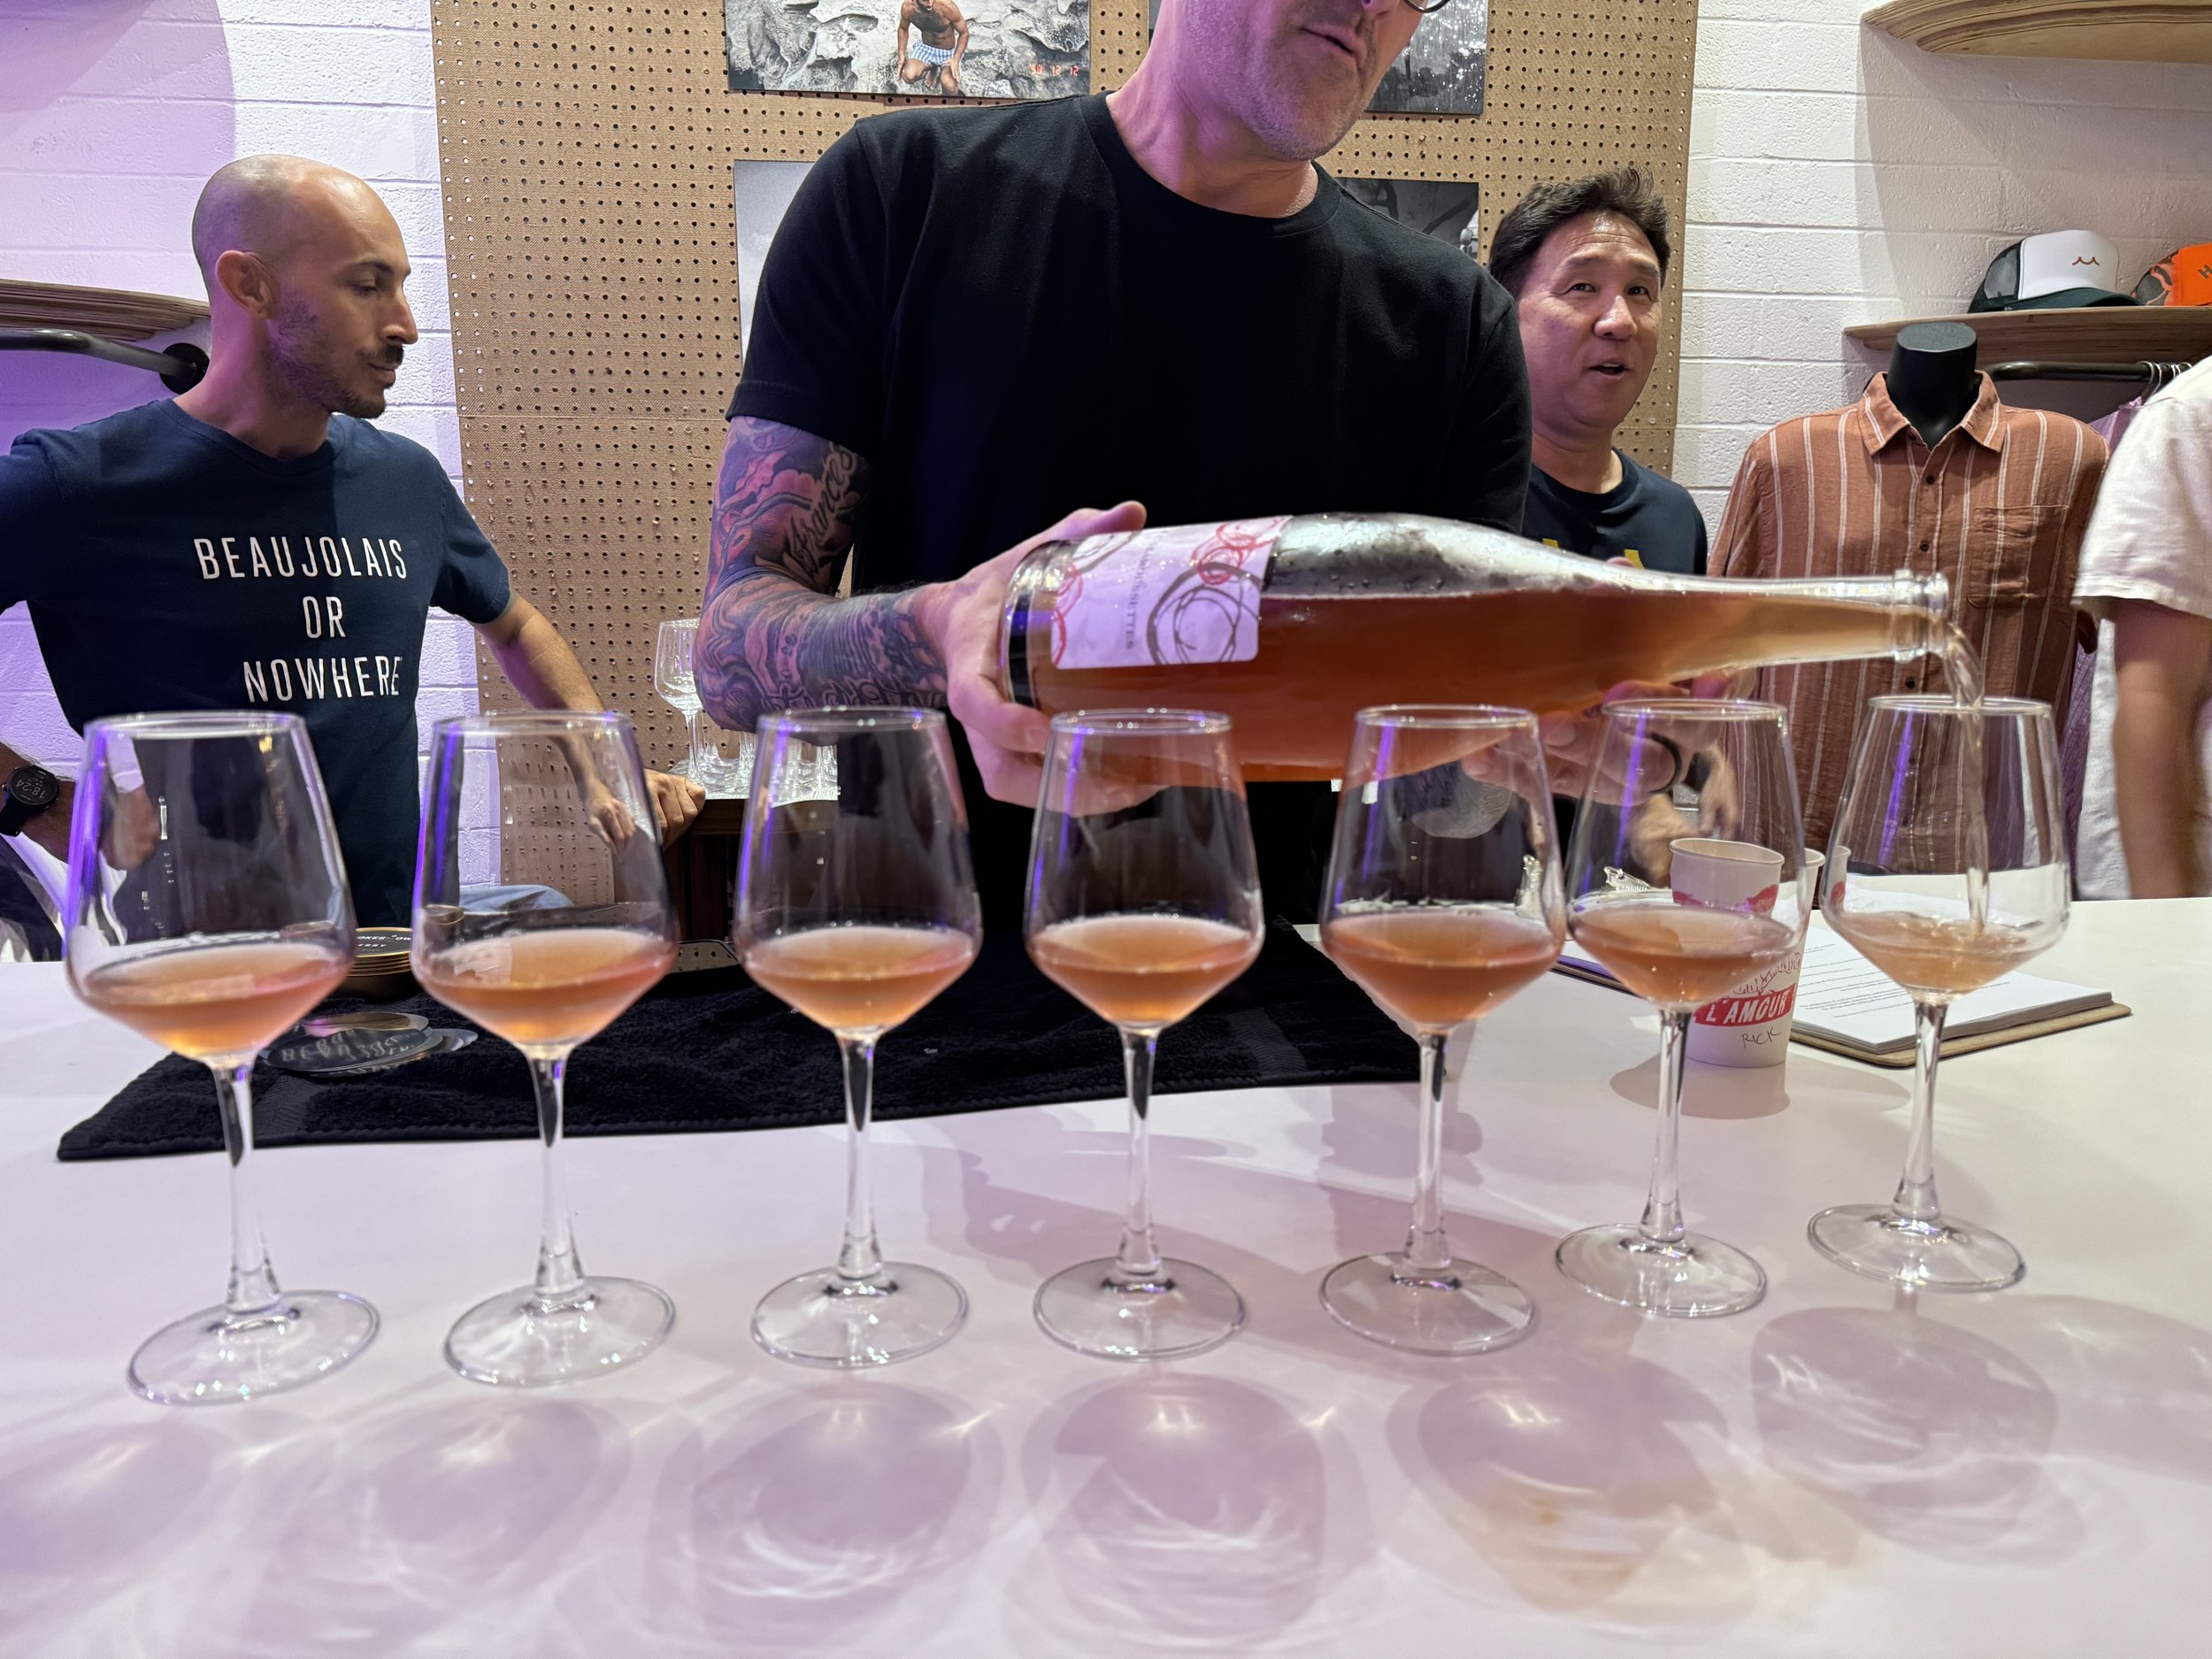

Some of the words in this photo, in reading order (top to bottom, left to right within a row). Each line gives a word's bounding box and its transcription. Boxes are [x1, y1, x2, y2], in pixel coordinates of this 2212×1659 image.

[1069, 65, 1080, 76] 12
[194, 536, 407, 580] BEAUJOLAIS
[302, 595, 347, 639] OR
[243, 656, 403, 703] NOWHERE
[15, 779, 46, 799] 18:24
[1741, 1026, 1781, 1048] RICK
